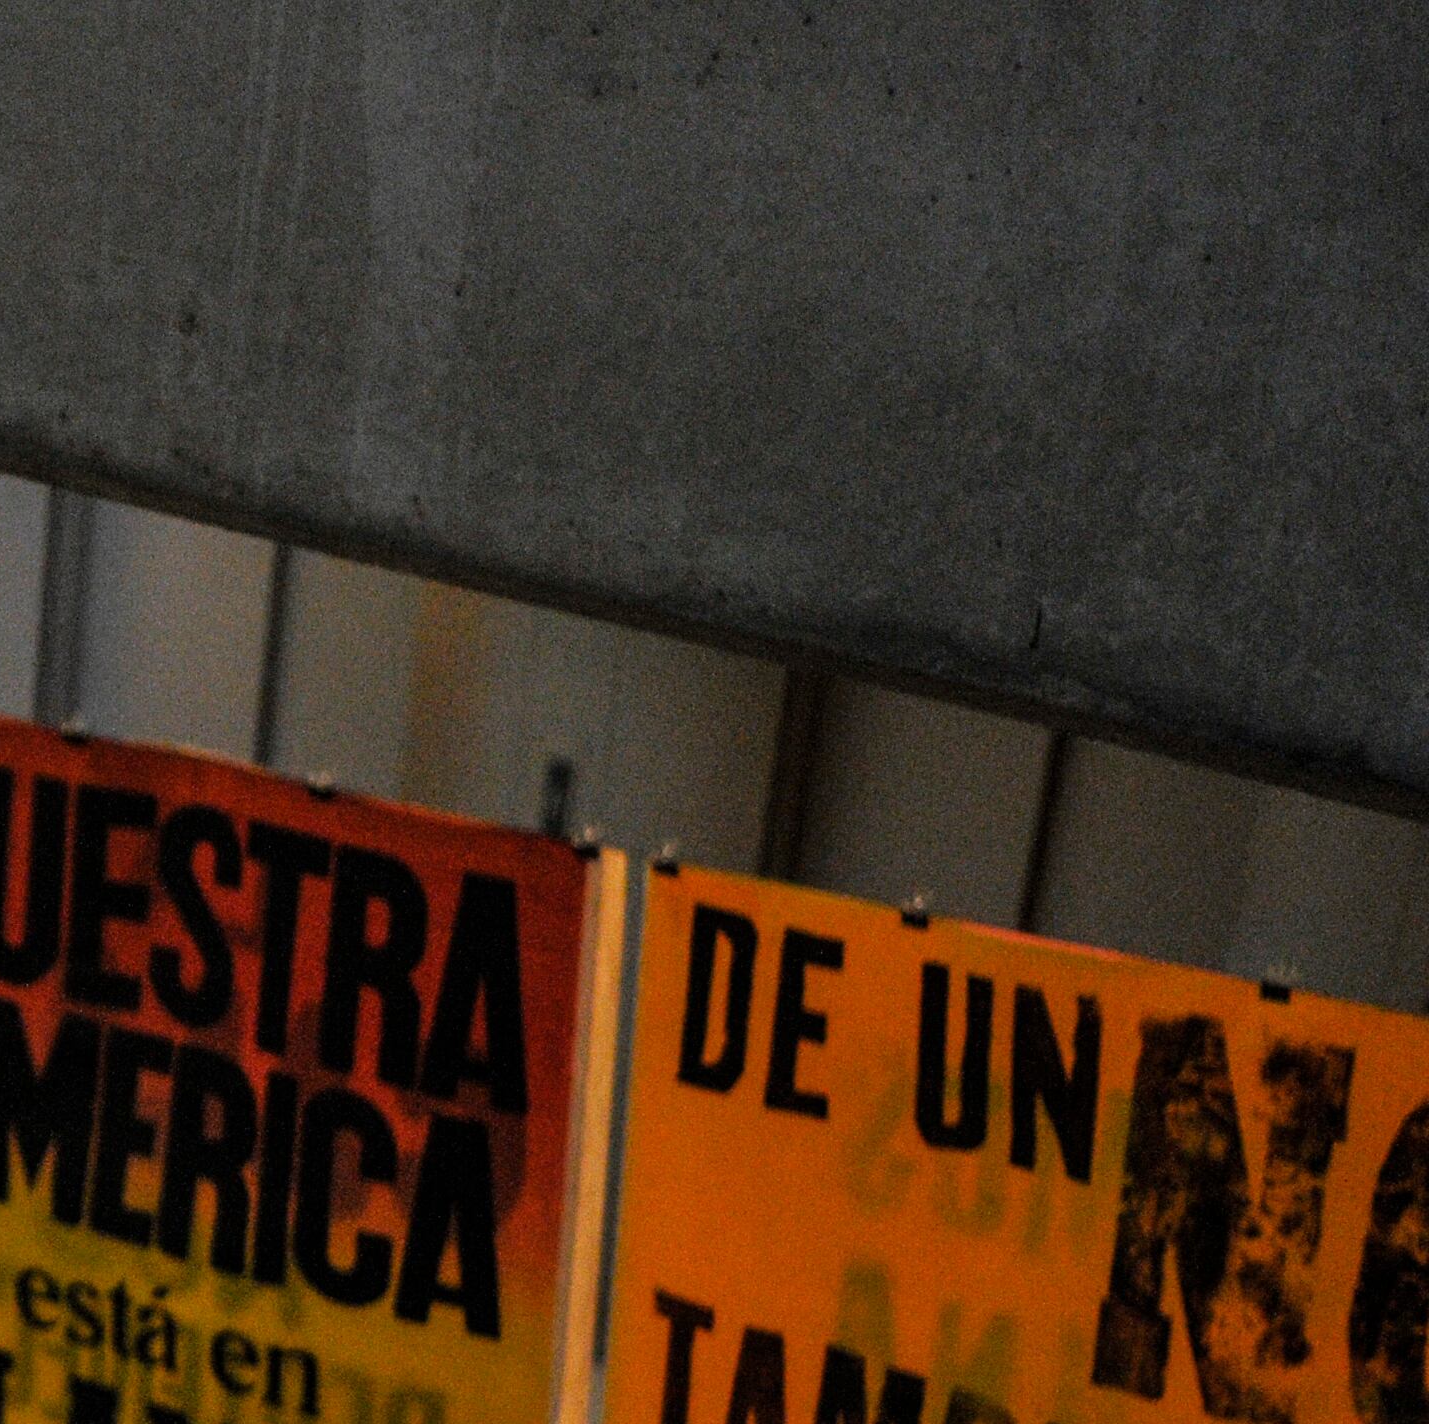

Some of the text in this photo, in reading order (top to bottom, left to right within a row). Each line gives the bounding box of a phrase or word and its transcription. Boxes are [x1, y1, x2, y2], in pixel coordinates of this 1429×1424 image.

[676, 902, 846, 1122] DE
[913, 960, 1103, 1187] UN
[16, 1266, 323, 1420] está en
